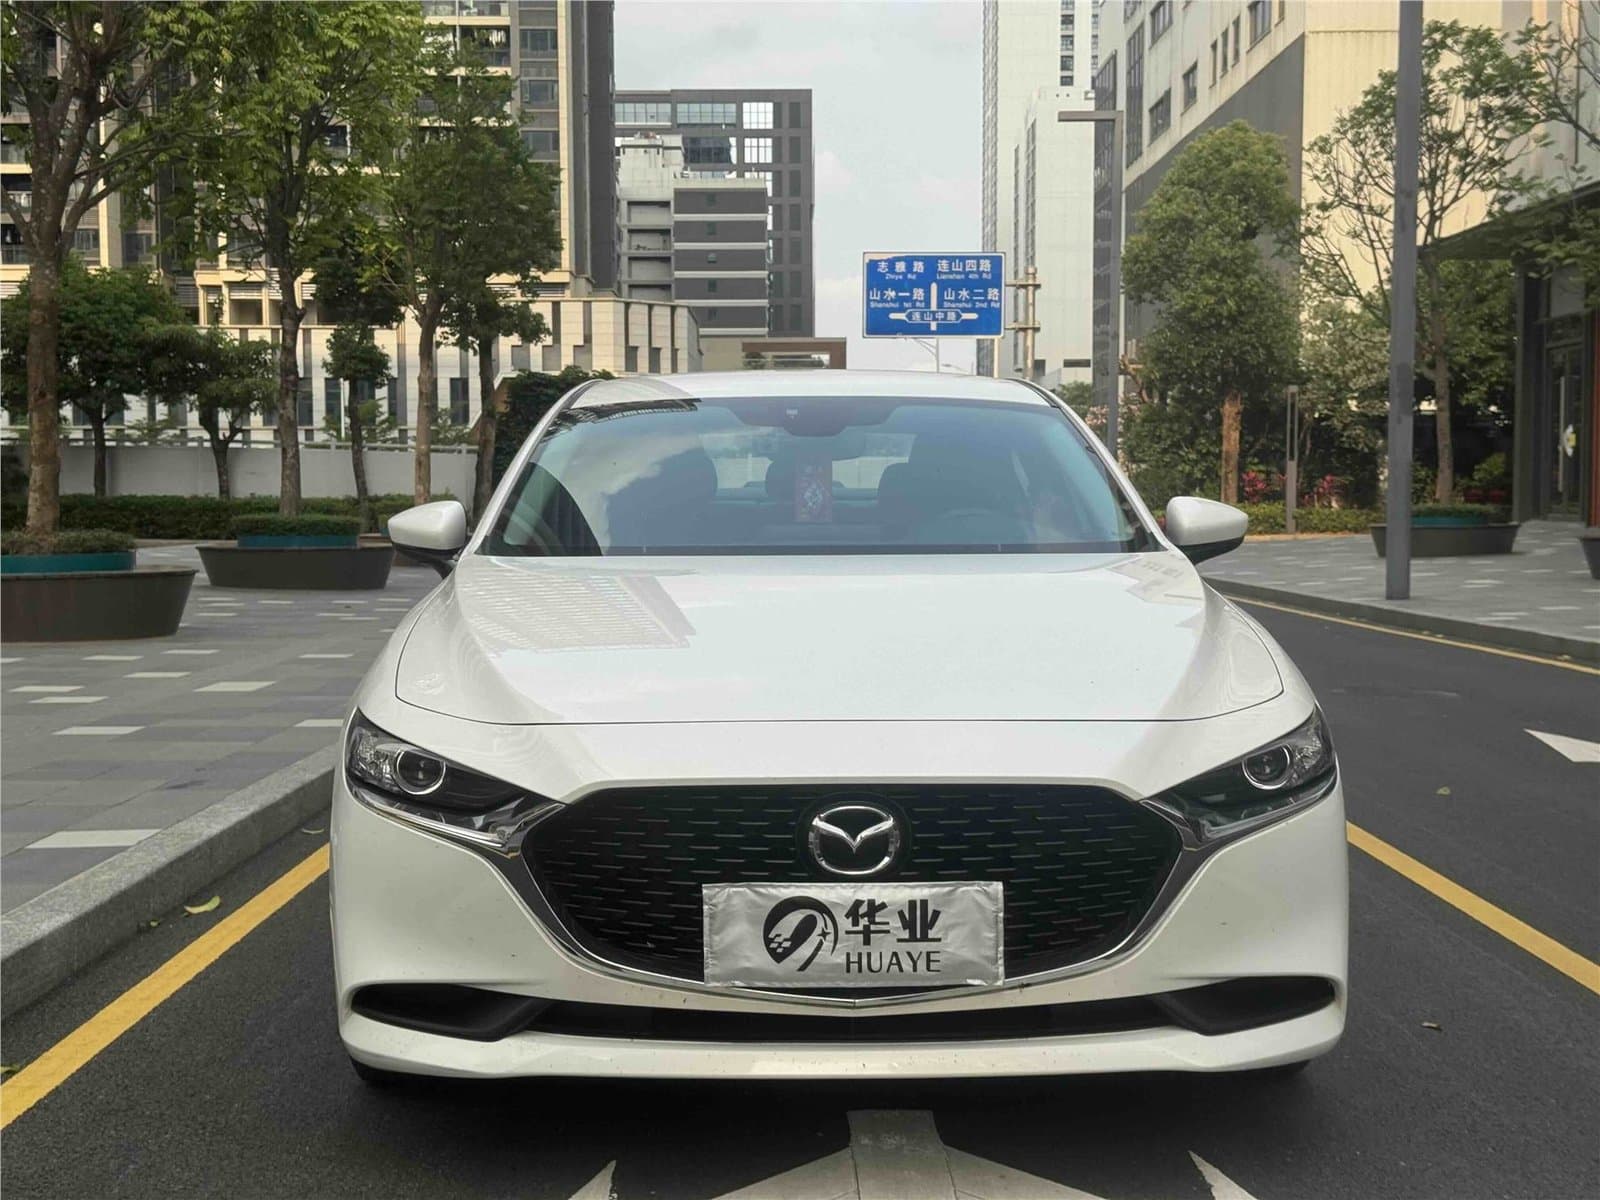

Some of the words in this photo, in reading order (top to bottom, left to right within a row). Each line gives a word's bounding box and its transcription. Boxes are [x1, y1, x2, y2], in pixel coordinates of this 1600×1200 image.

[937, 259, 991, 272] 连山四路
[869, 288, 924, 301] 山水一路
[944, 287, 1000, 301] 山水二路
[911, 311, 956, 321] 连山中路
[844, 898, 942, 946] 华业
[846, 951, 941, 974] HUAYE
